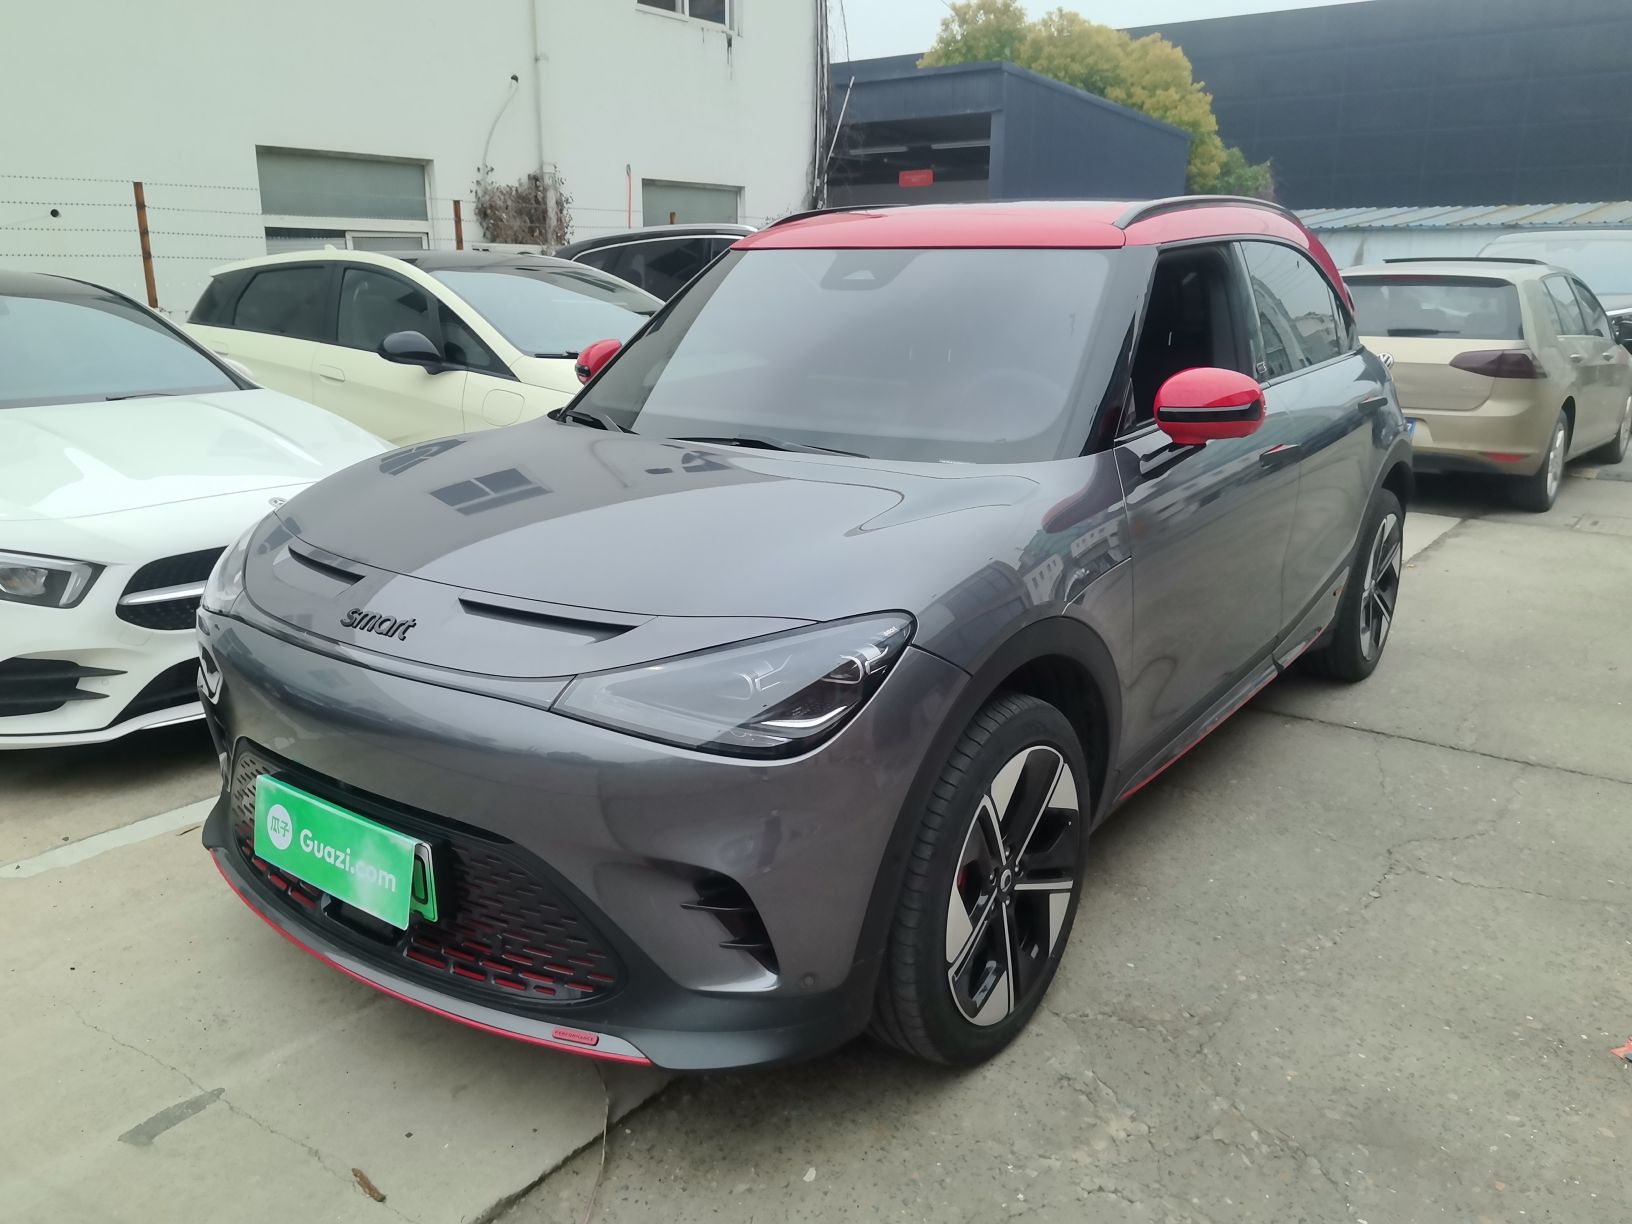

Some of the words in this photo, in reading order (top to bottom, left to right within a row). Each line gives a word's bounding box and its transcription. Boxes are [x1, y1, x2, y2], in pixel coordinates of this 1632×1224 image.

[340, 607, 417, 641] smart
[270, 814, 290, 838] 瓜子
[299, 828, 397, 893] Guazi.com
[554, 1030, 594, 1042] PERFORMANCE
